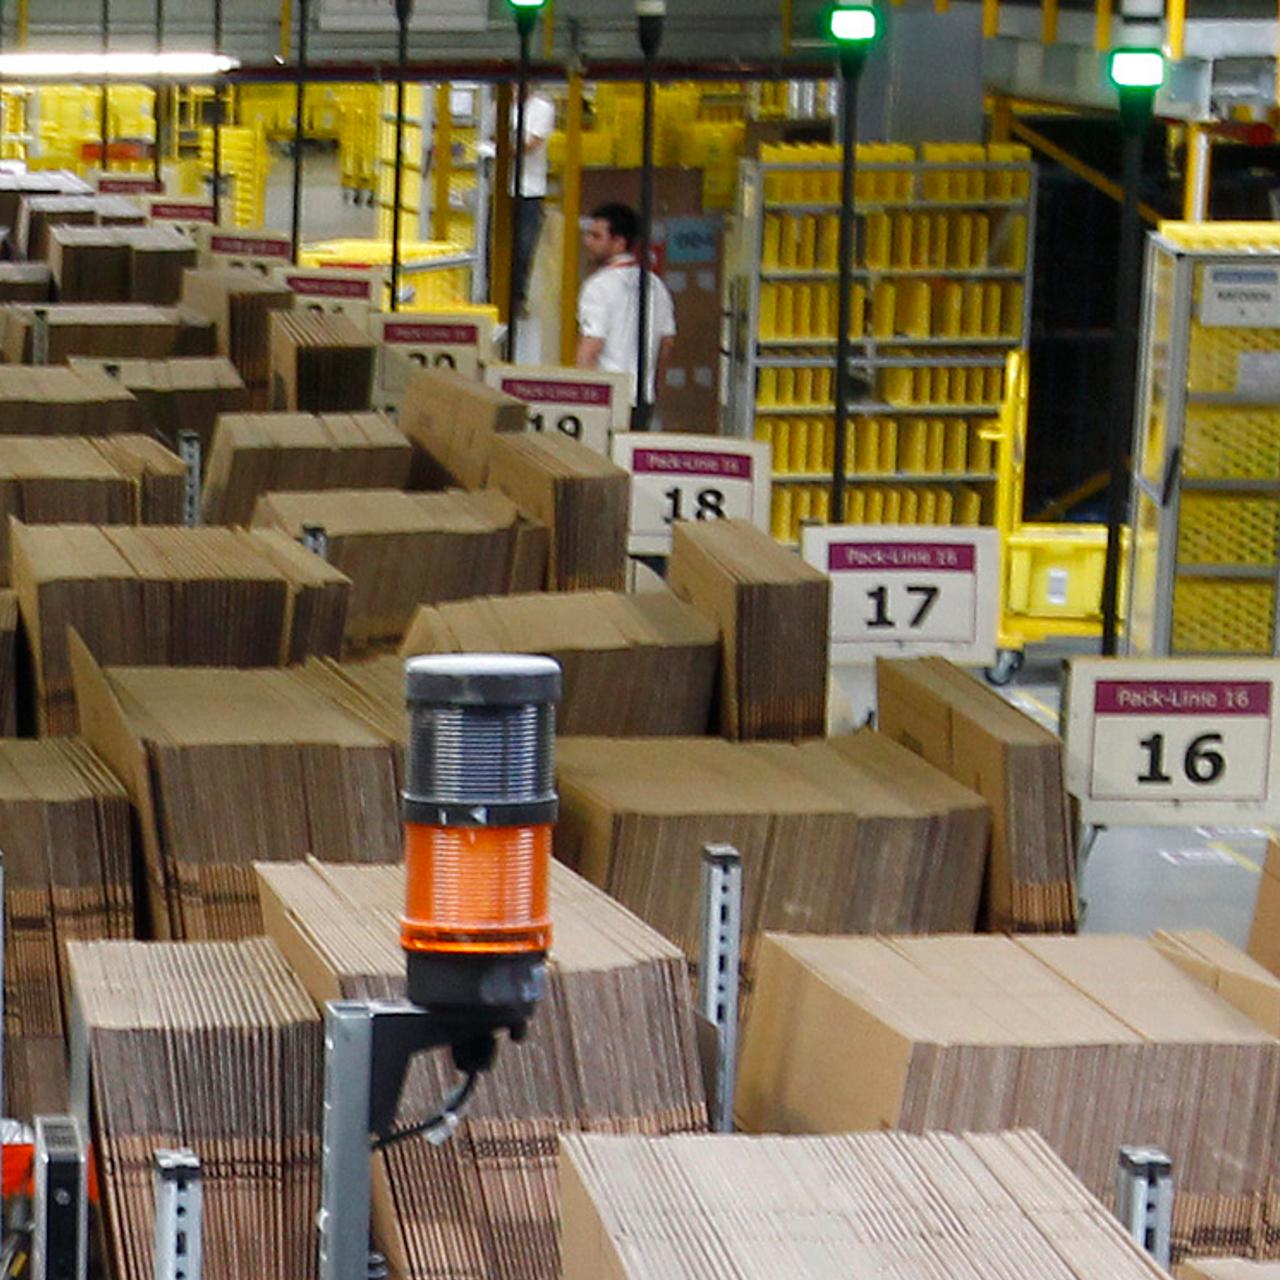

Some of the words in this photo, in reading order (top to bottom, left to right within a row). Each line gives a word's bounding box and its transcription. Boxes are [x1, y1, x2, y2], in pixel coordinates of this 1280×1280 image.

[664, 487, 727, 523] 18
[866, 585, 939, 628] 17
[1118, 687, 1217, 708] Pack-Linie
[1137, 732, 1227, 783] 16
